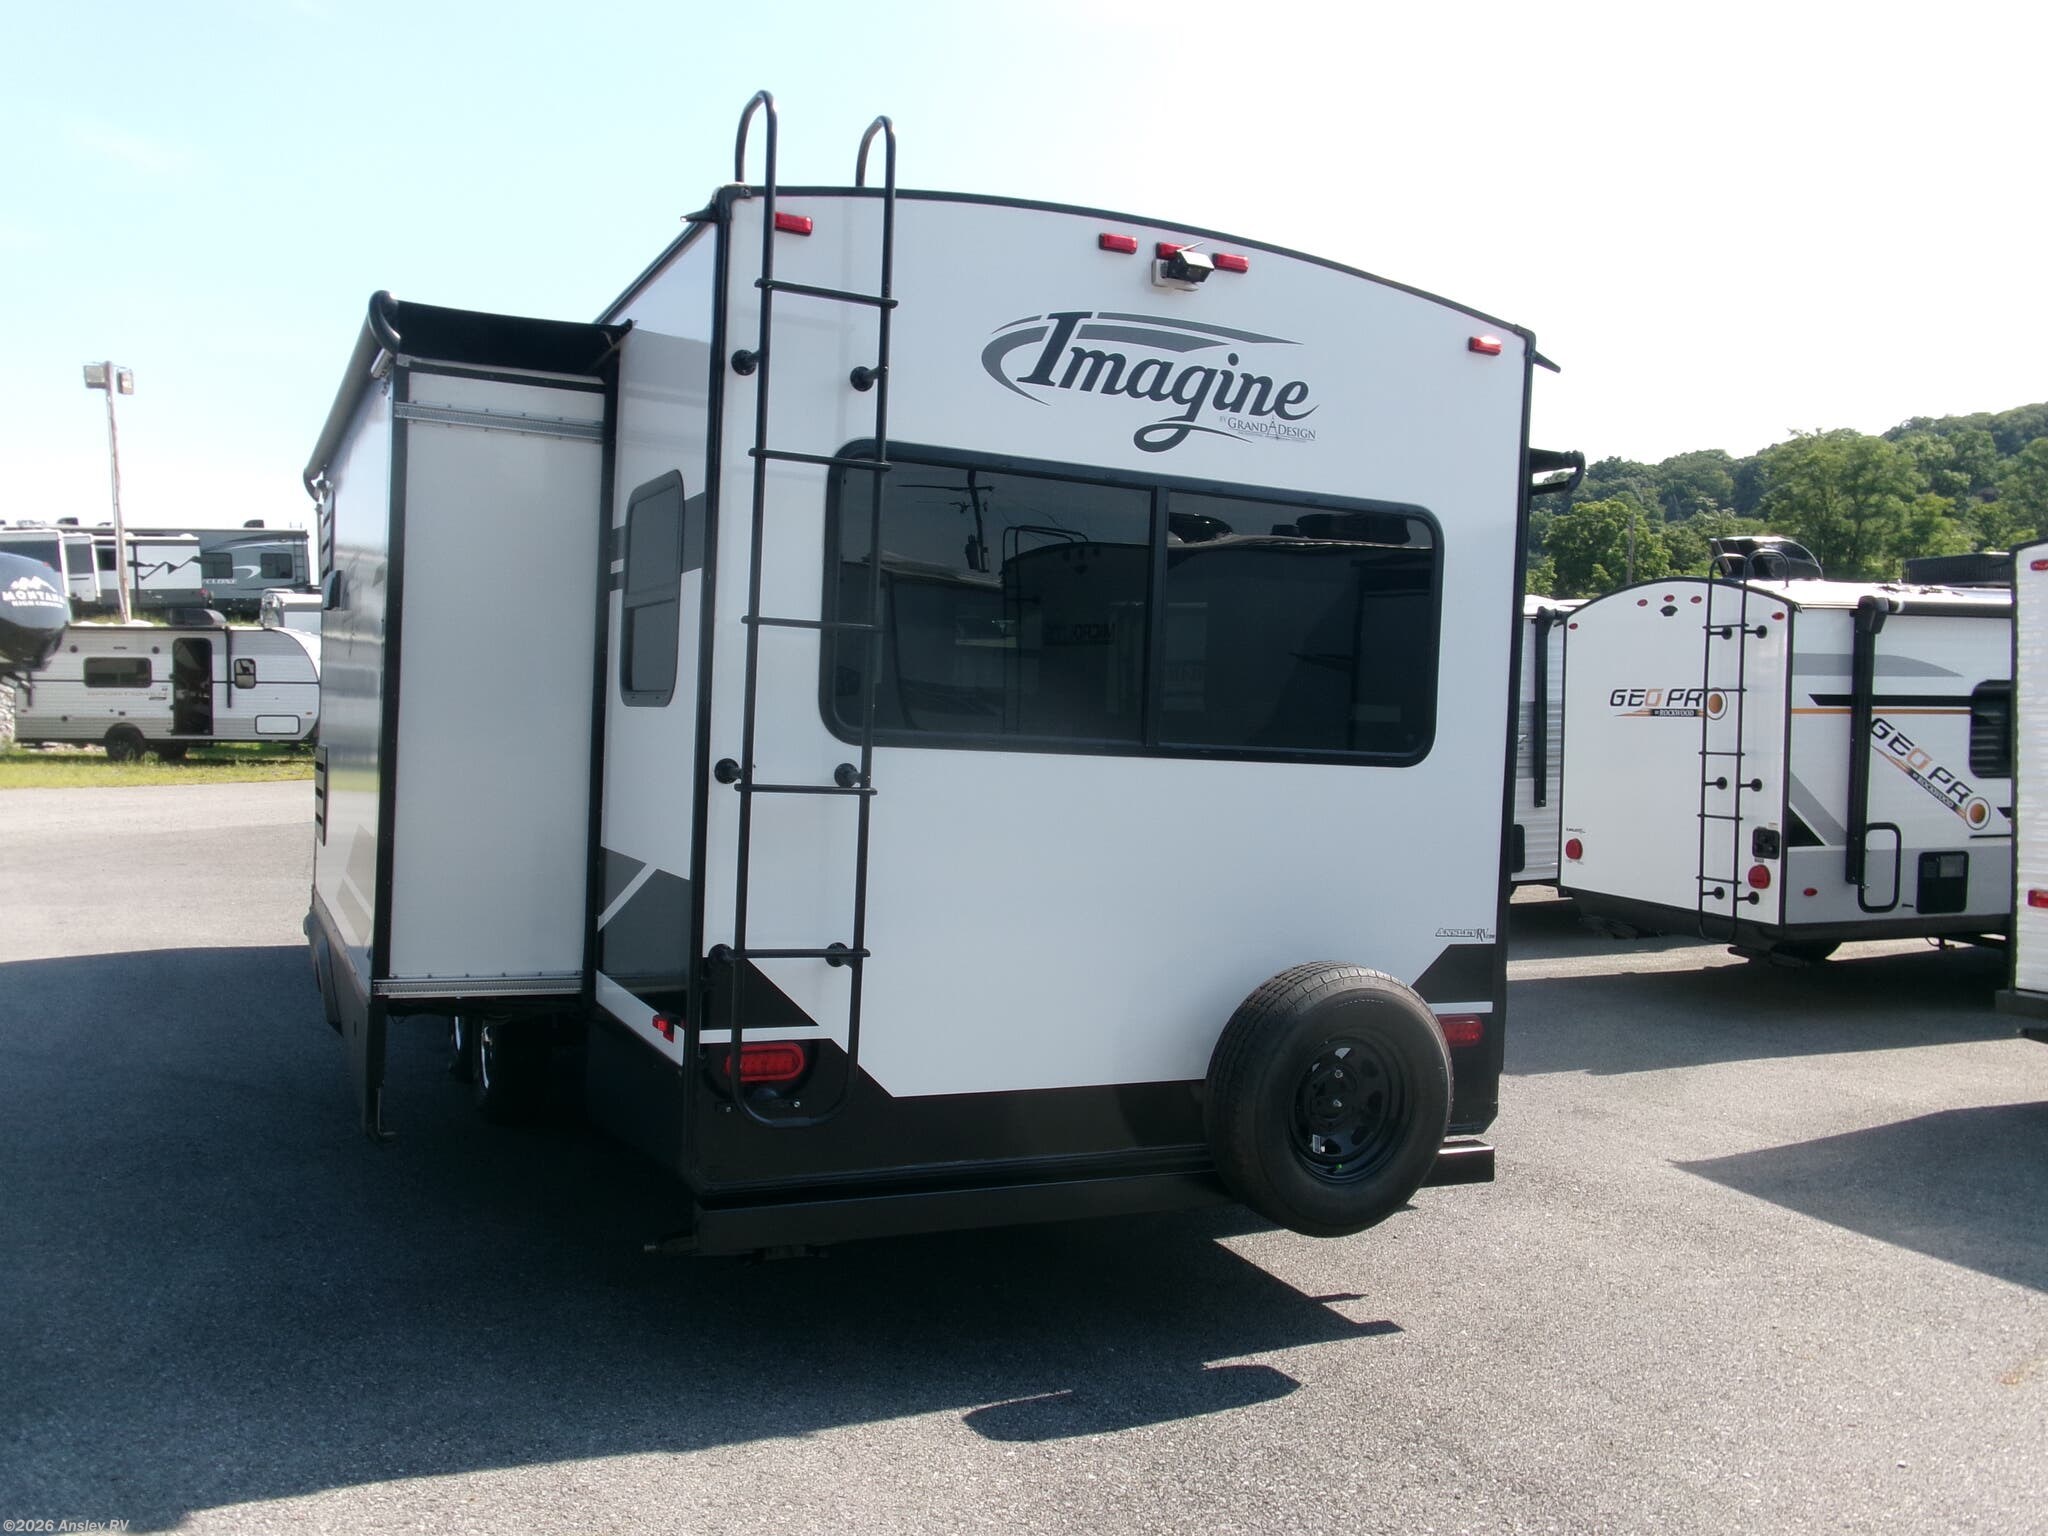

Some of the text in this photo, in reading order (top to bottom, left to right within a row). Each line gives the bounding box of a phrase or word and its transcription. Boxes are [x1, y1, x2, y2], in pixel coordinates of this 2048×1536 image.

[1015, 311, 1320, 453] Imagine
[1227, 417, 1268, 433] GRAND
[1278, 423, 1317, 439] DESIGN
[1609, 688, 1664, 707] GEO
[1871, 717, 1933, 771] GEO
